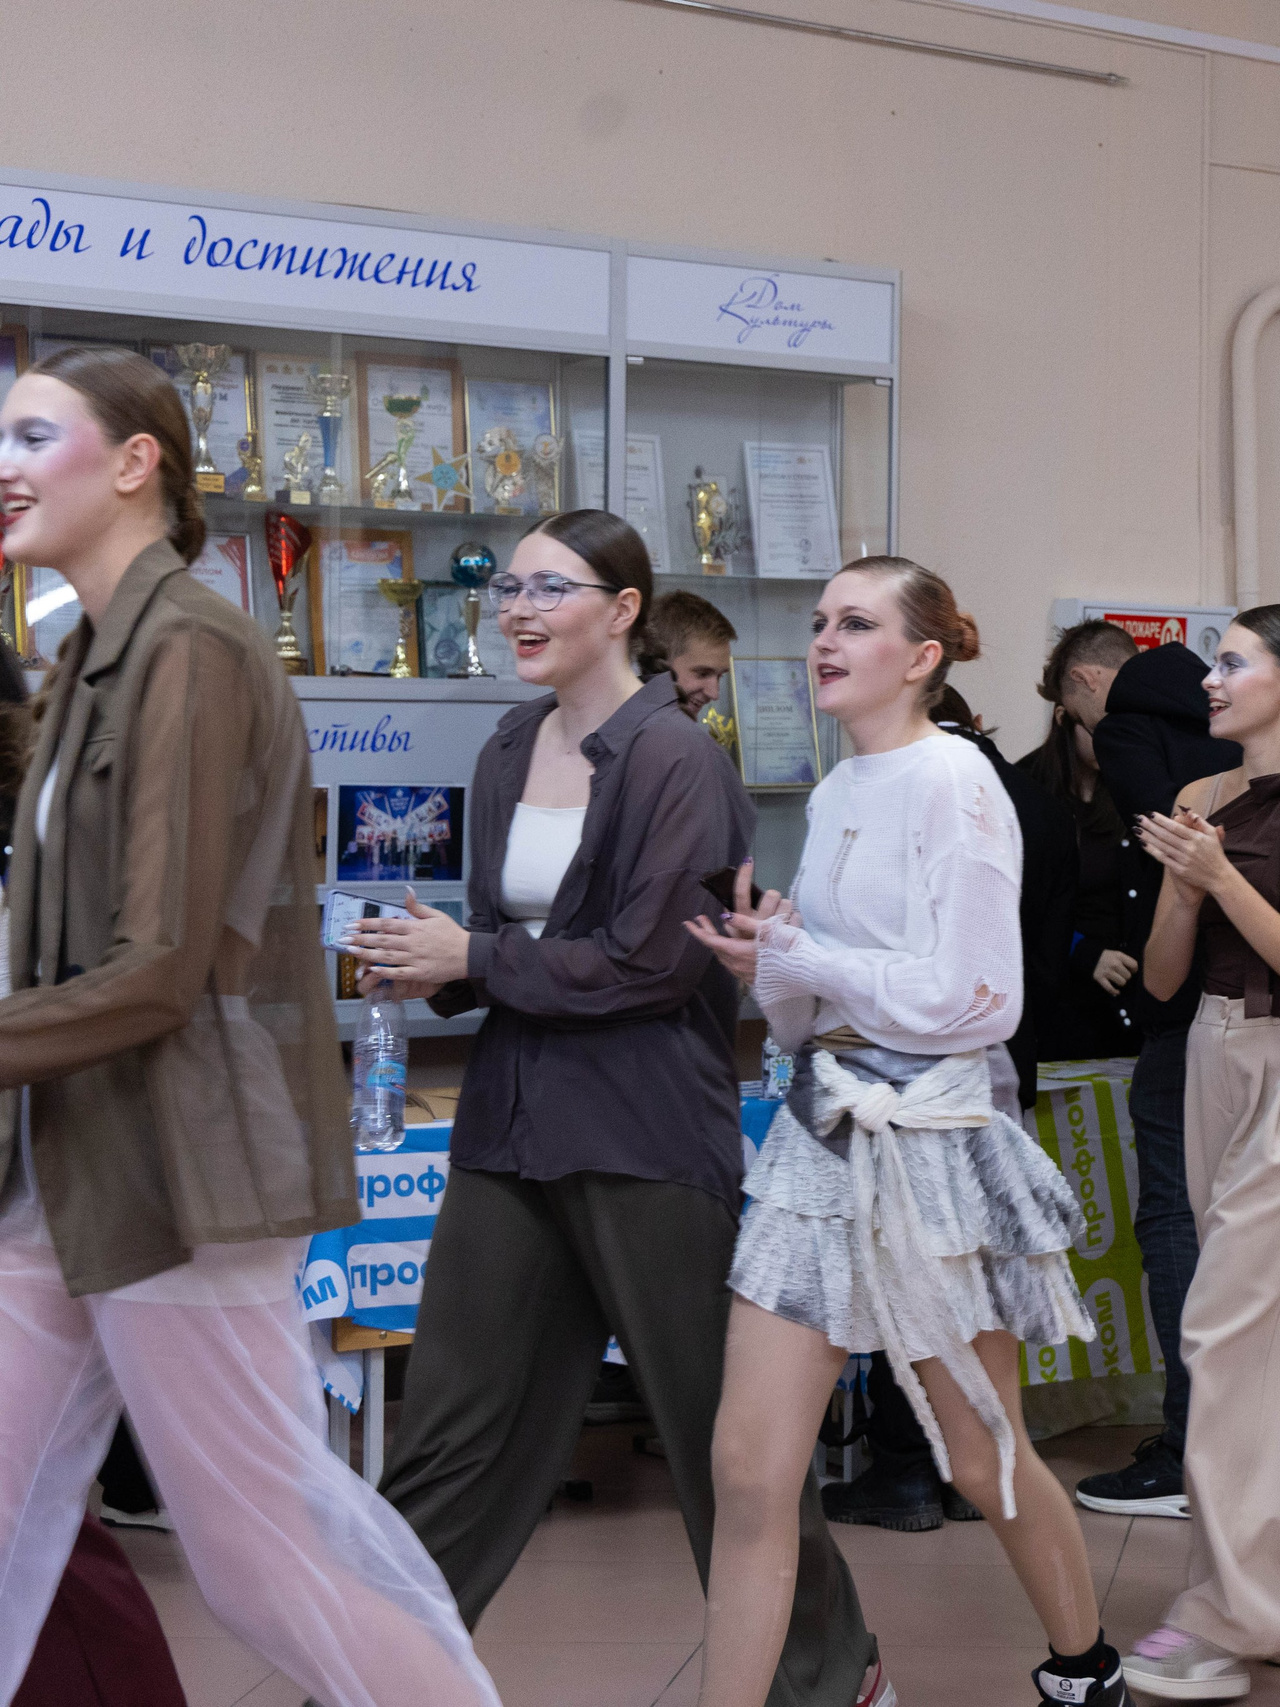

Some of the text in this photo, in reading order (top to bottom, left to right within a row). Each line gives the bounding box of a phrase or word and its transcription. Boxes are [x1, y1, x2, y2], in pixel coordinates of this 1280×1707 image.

[119, 227, 154, 260] и
[184, 214, 482, 293] достижения
[740, 273, 804, 312] Дом
[716, 290, 836, 348] Культуры
[350, 1260, 428, 1297] про
